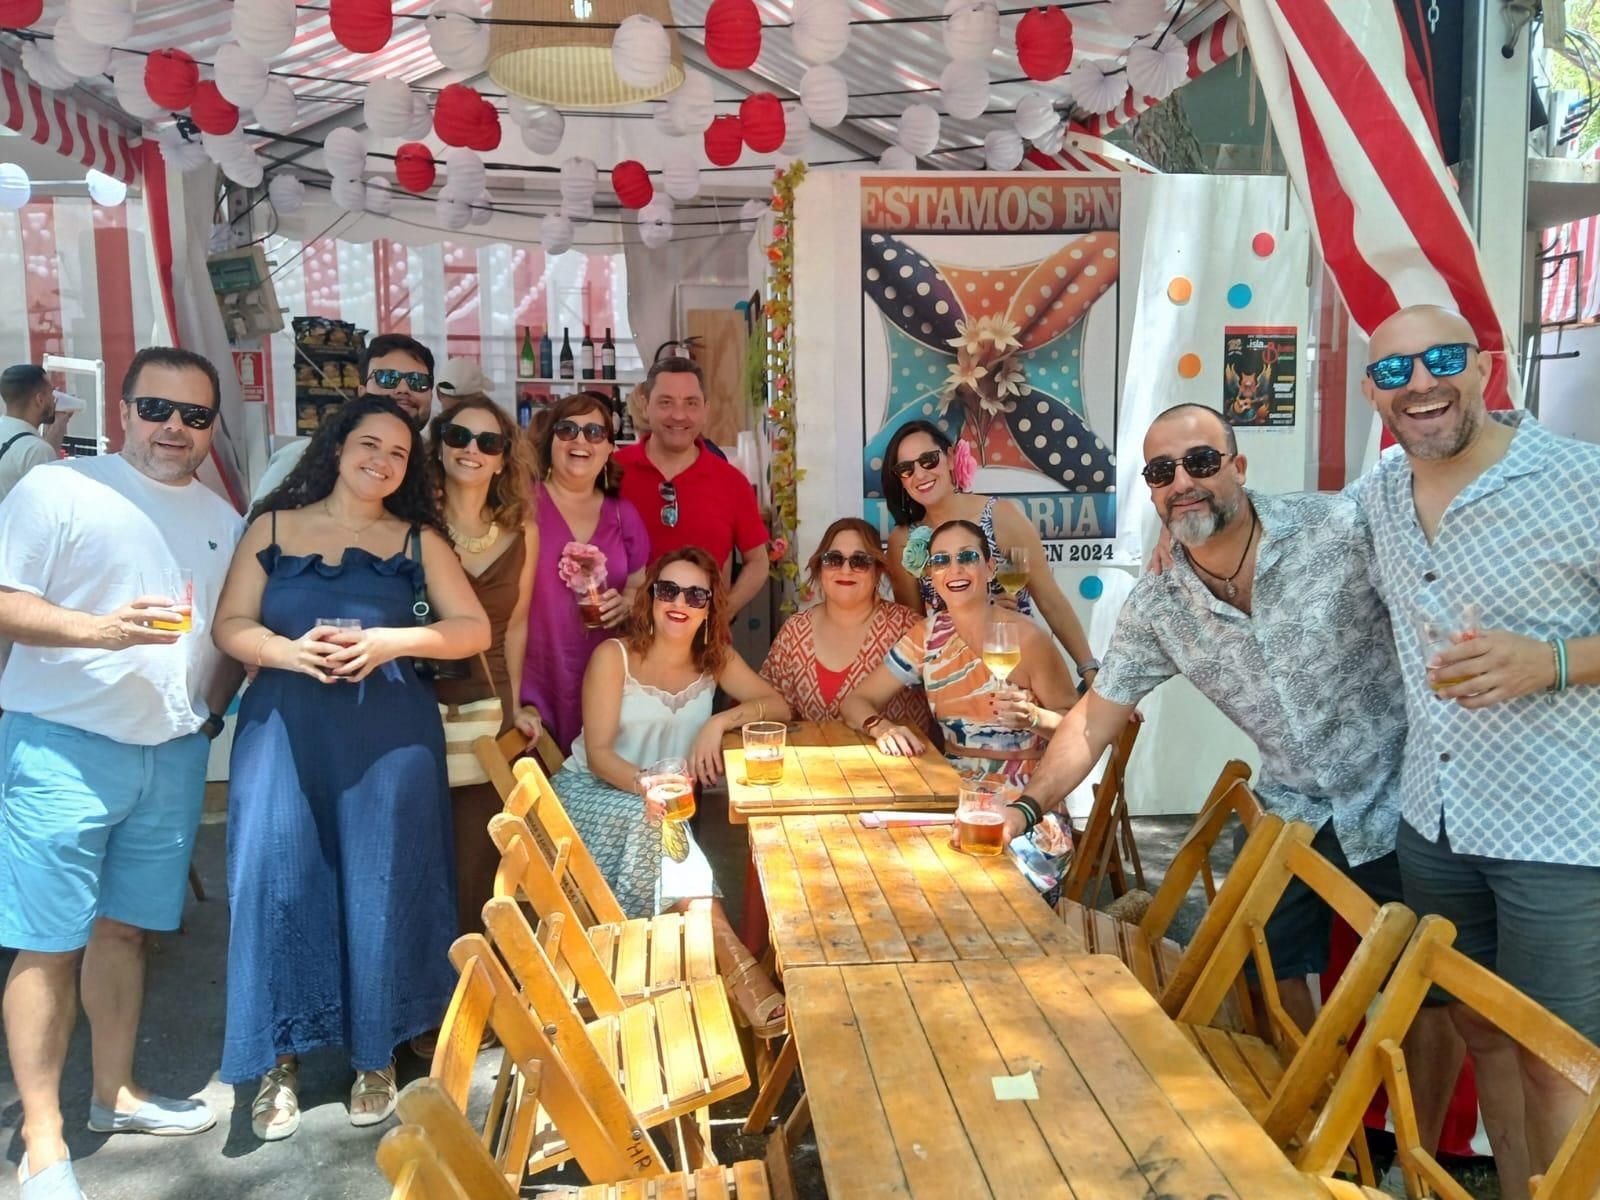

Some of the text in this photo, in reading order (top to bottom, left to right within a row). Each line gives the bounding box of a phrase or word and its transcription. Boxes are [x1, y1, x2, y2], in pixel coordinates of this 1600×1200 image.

[862, 185, 1121, 232] ESTAMOS EN
[1010, 496, 1102, 539] RIA
[1070, 544, 1114, 562] 2024
